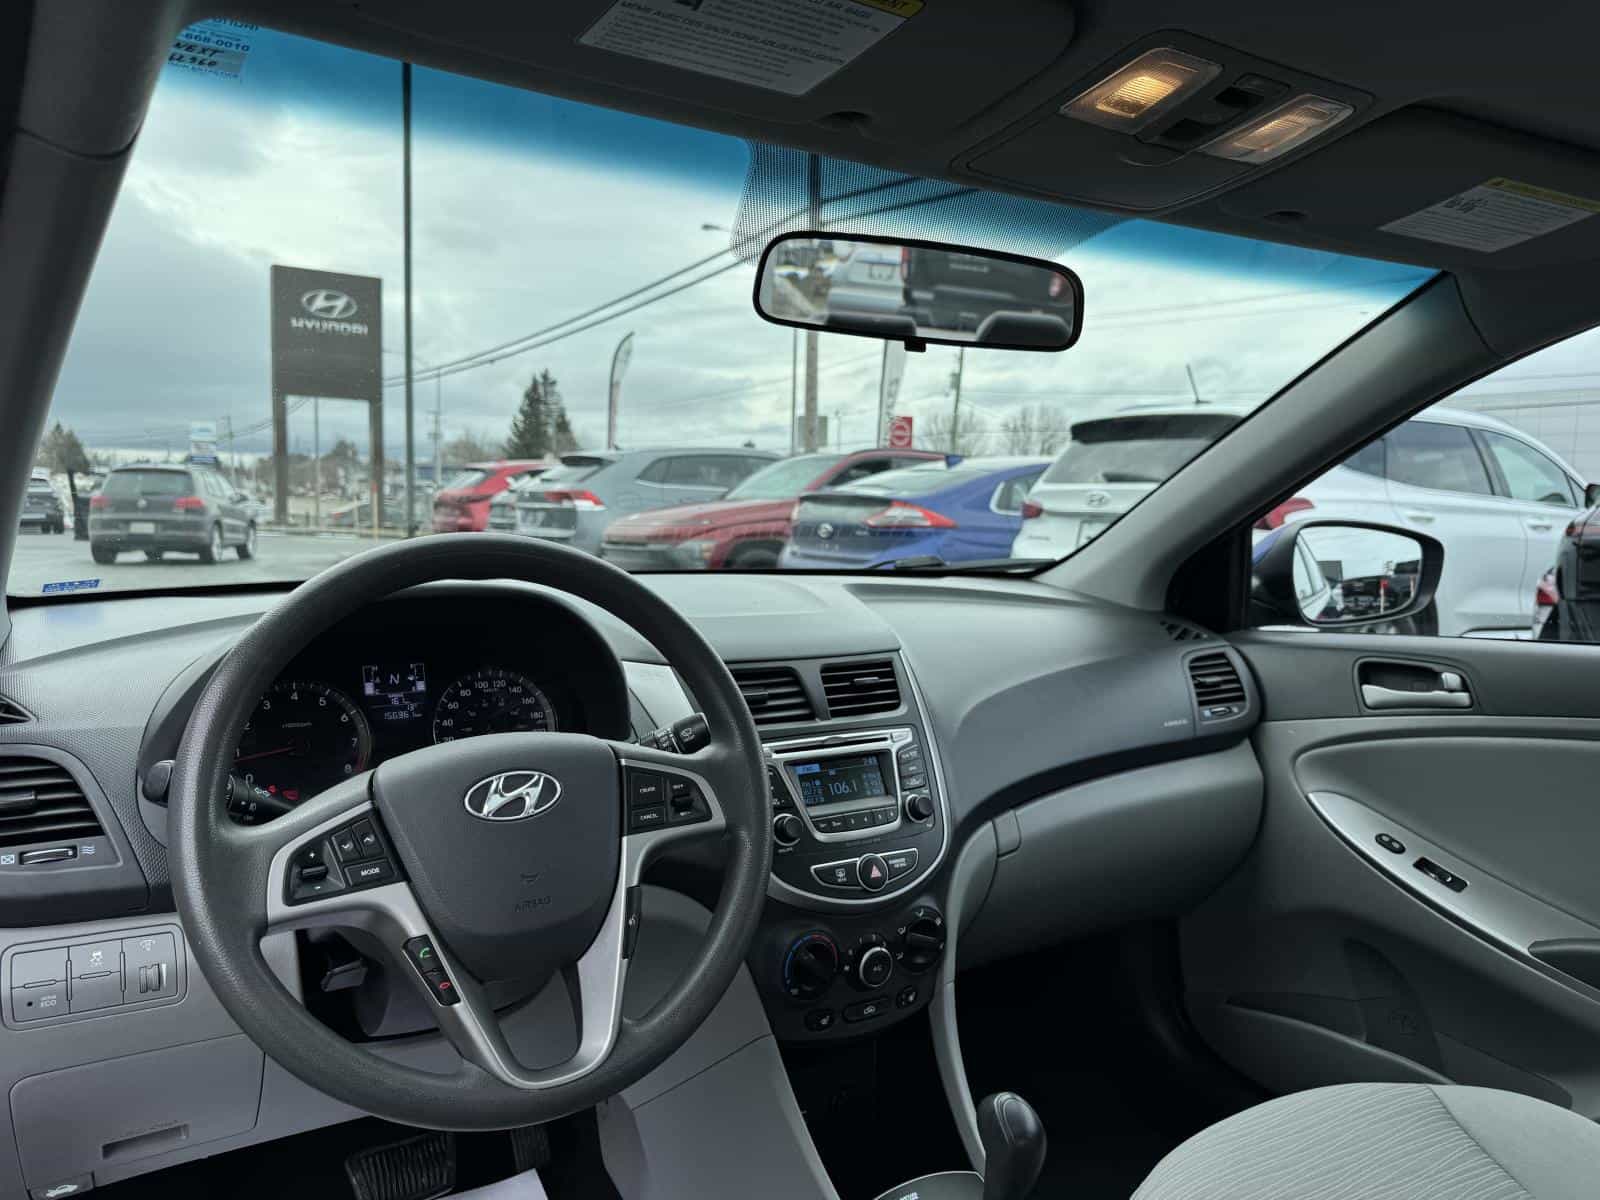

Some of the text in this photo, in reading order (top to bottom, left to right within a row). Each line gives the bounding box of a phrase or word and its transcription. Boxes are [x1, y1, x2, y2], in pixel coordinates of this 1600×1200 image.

[290, 317, 369, 335] HYUNDAI
[390, 674, 400, 685] N
[474, 681, 489, 690] 100
[493, 680, 507, 689] 120
[460, 689, 472, 698] 80
[508, 687, 523, 695] 140
[290, 692, 299, 701] 4
[521, 697, 536, 705] 160
[263, 701, 271, 711] 3
[319, 697, 327, 707] 5
[447, 702, 459, 710] 60
[340, 713, 349, 723] 6
[442, 719, 454, 727] 40
[344, 764, 353, 774] 8
[829, 779, 858, 796] 106.1
[360, 867, 381, 877] MODE
